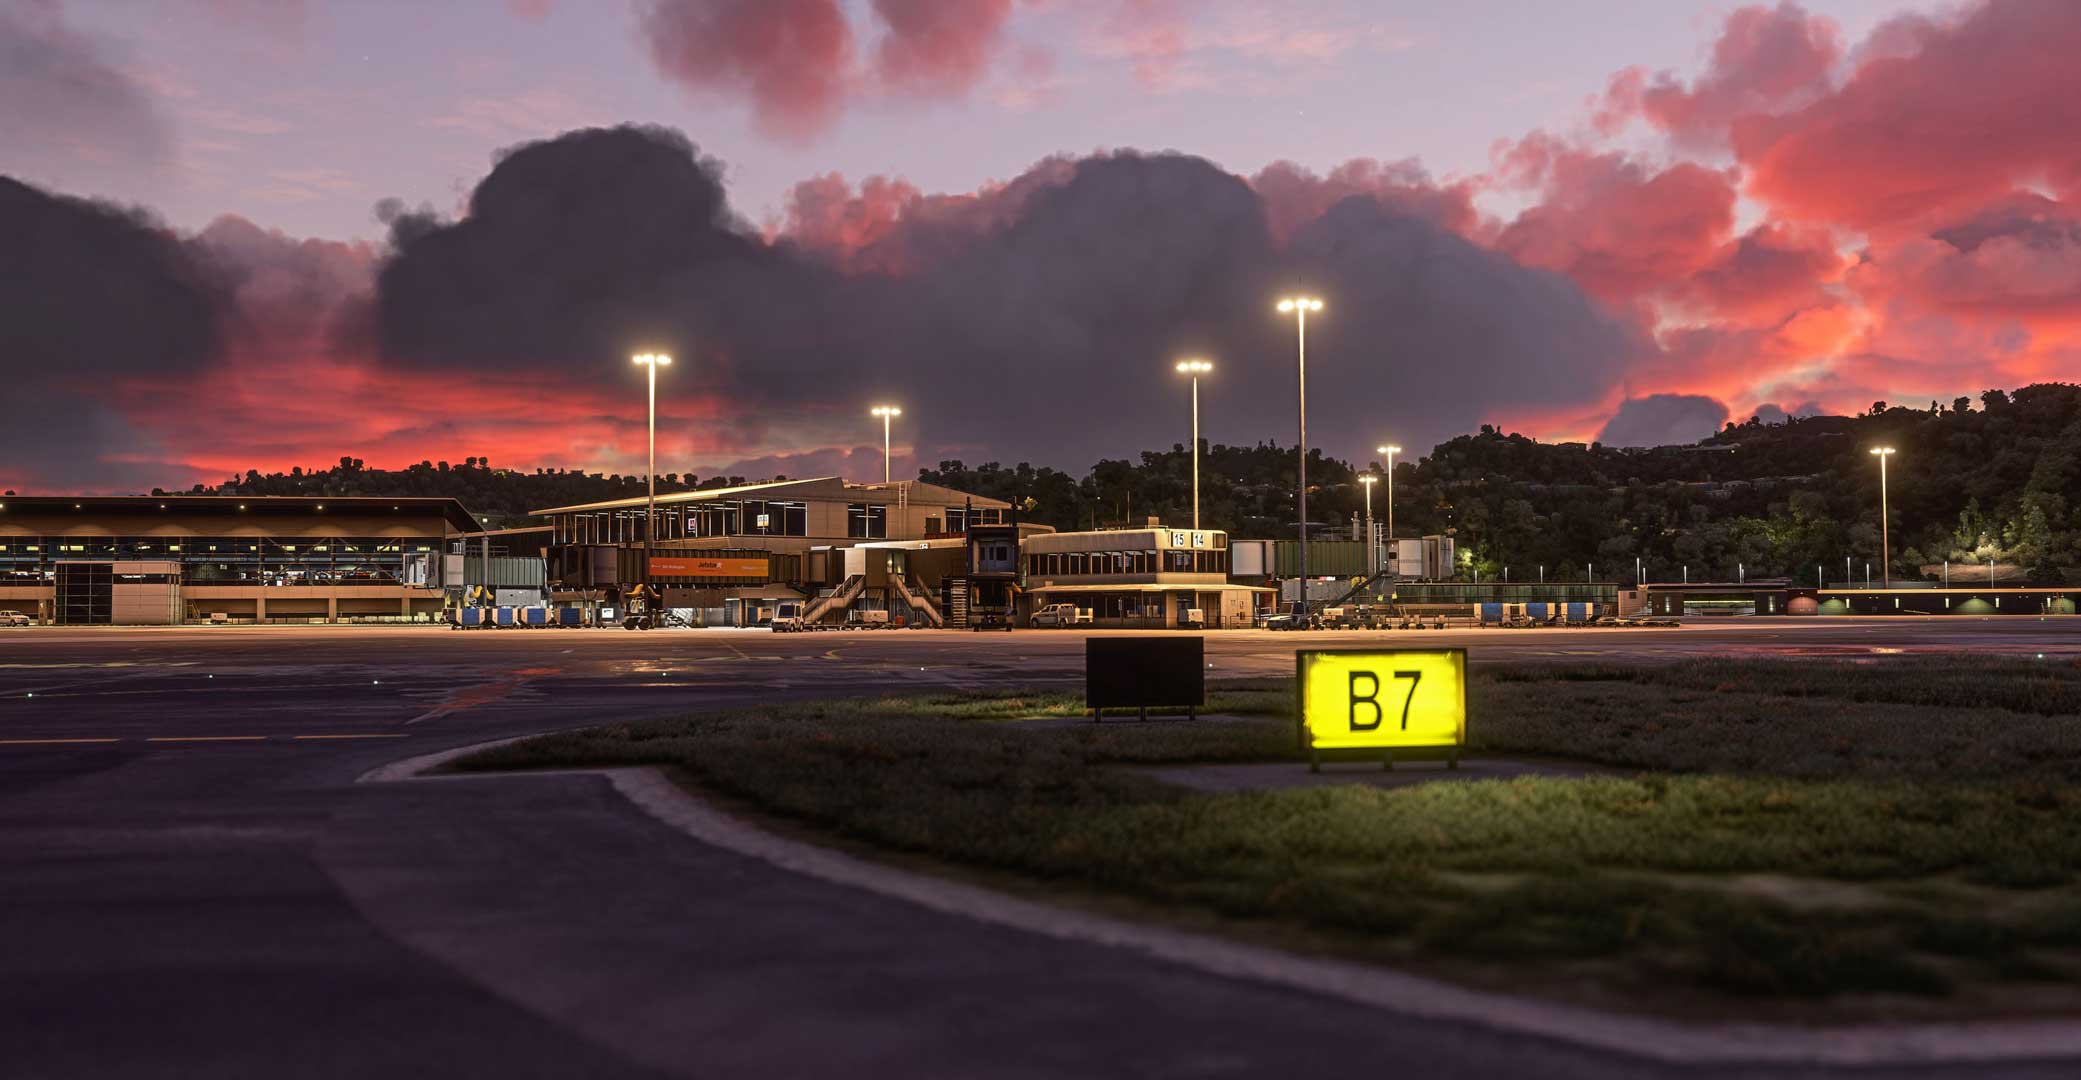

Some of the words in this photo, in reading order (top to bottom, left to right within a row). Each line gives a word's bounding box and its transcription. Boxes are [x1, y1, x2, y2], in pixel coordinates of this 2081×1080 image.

[1175, 534, 1184, 545] 15
[1195, 534, 1203, 545] 14
[1349, 671, 1422, 731] B7
